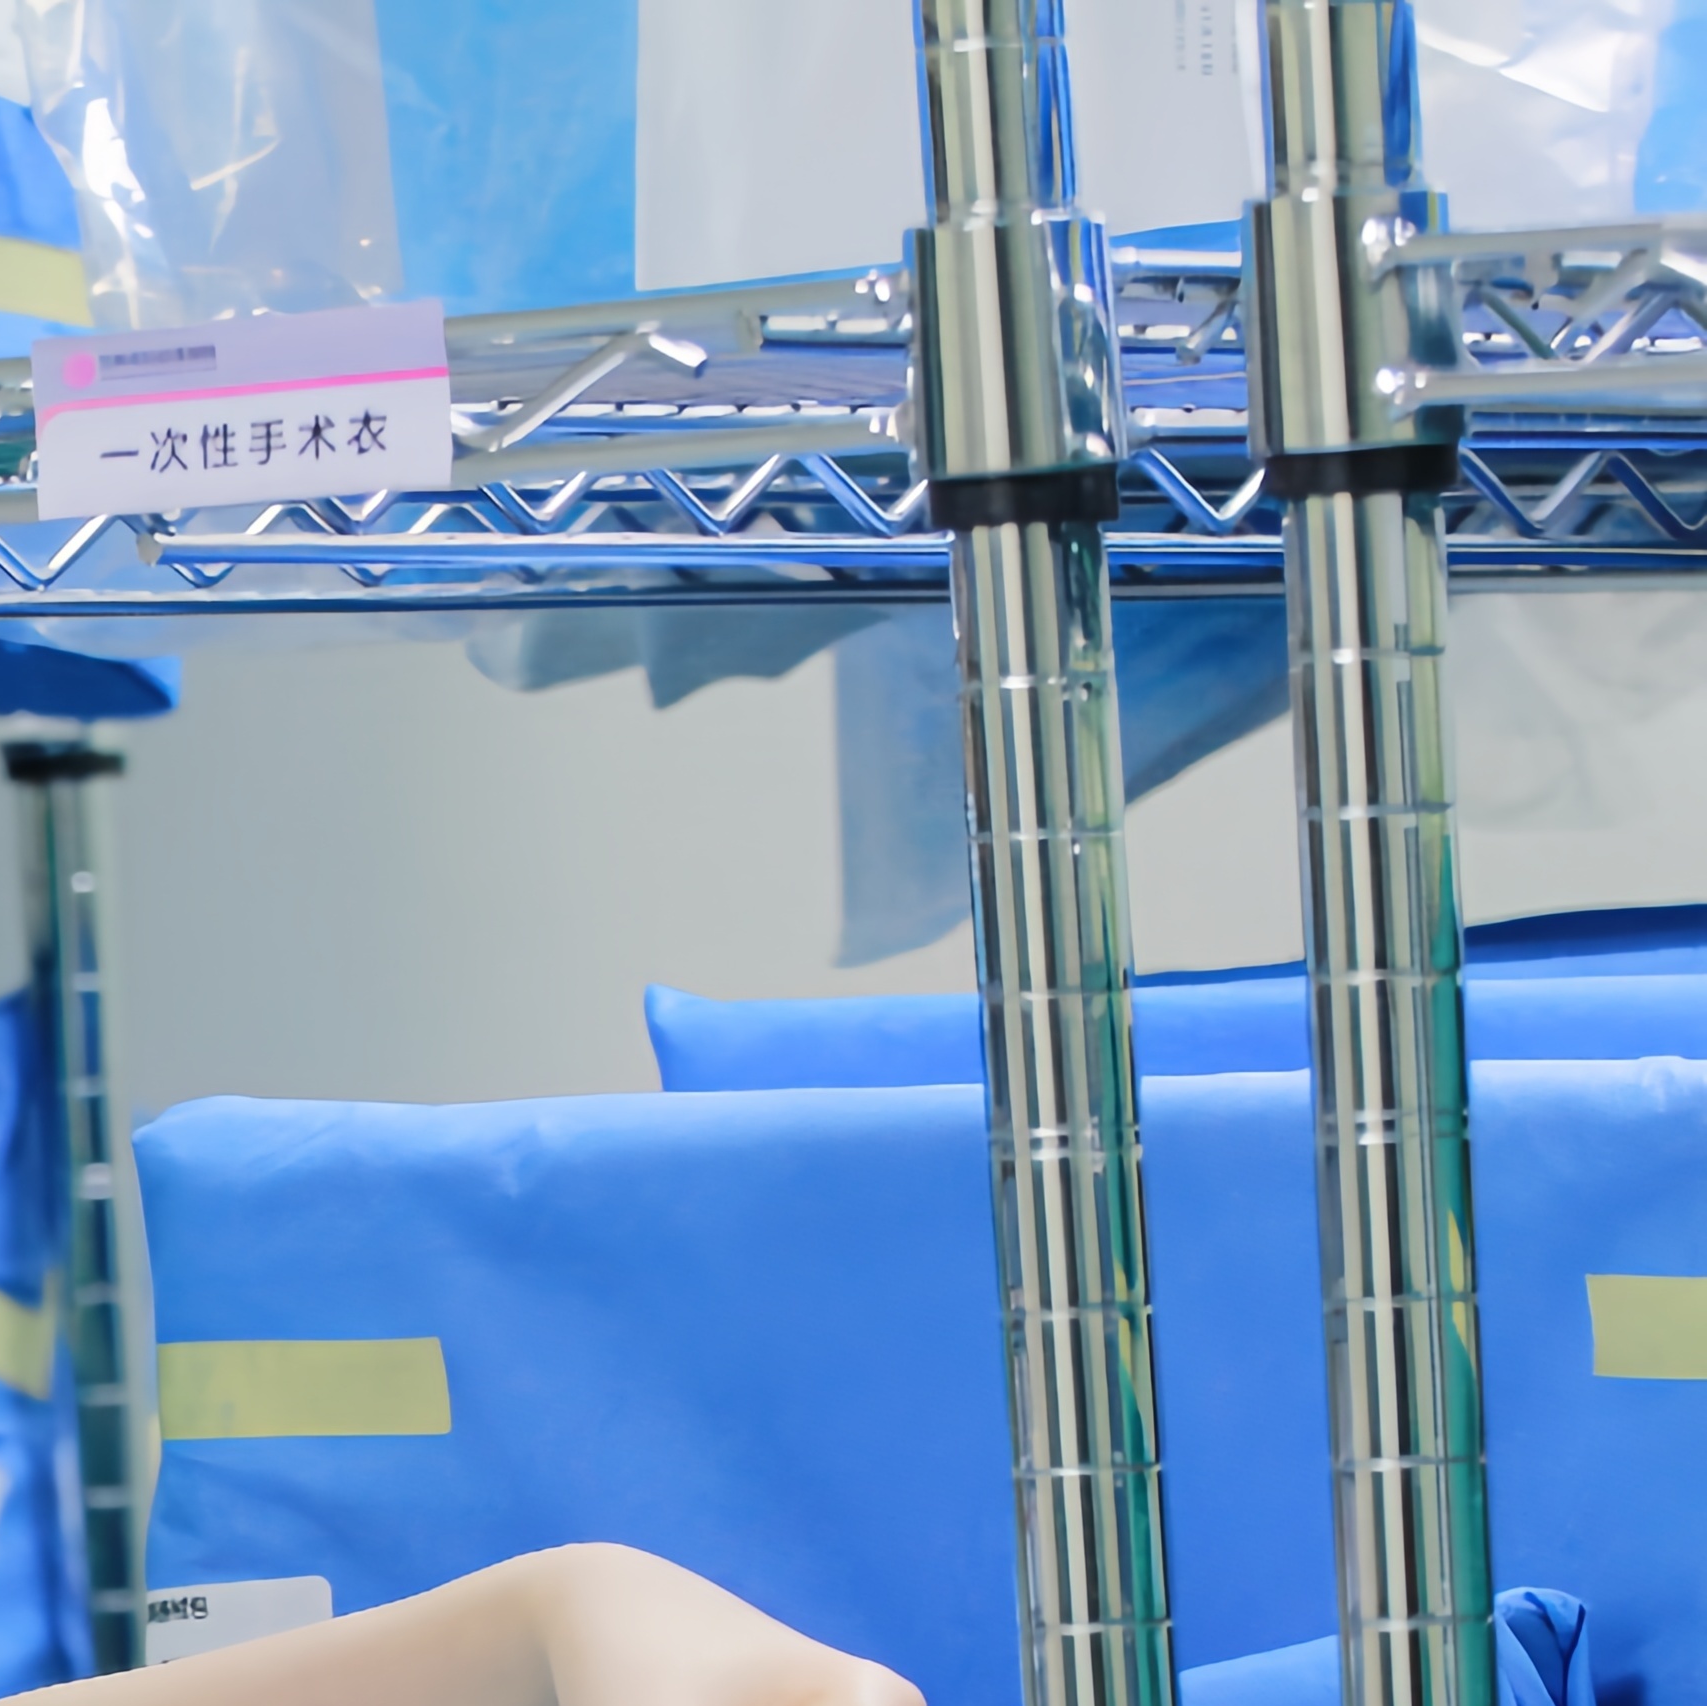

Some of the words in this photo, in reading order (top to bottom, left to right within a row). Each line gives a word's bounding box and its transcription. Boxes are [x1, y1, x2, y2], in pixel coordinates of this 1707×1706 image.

[99, 409, 388, 474] 一次性手术衣
